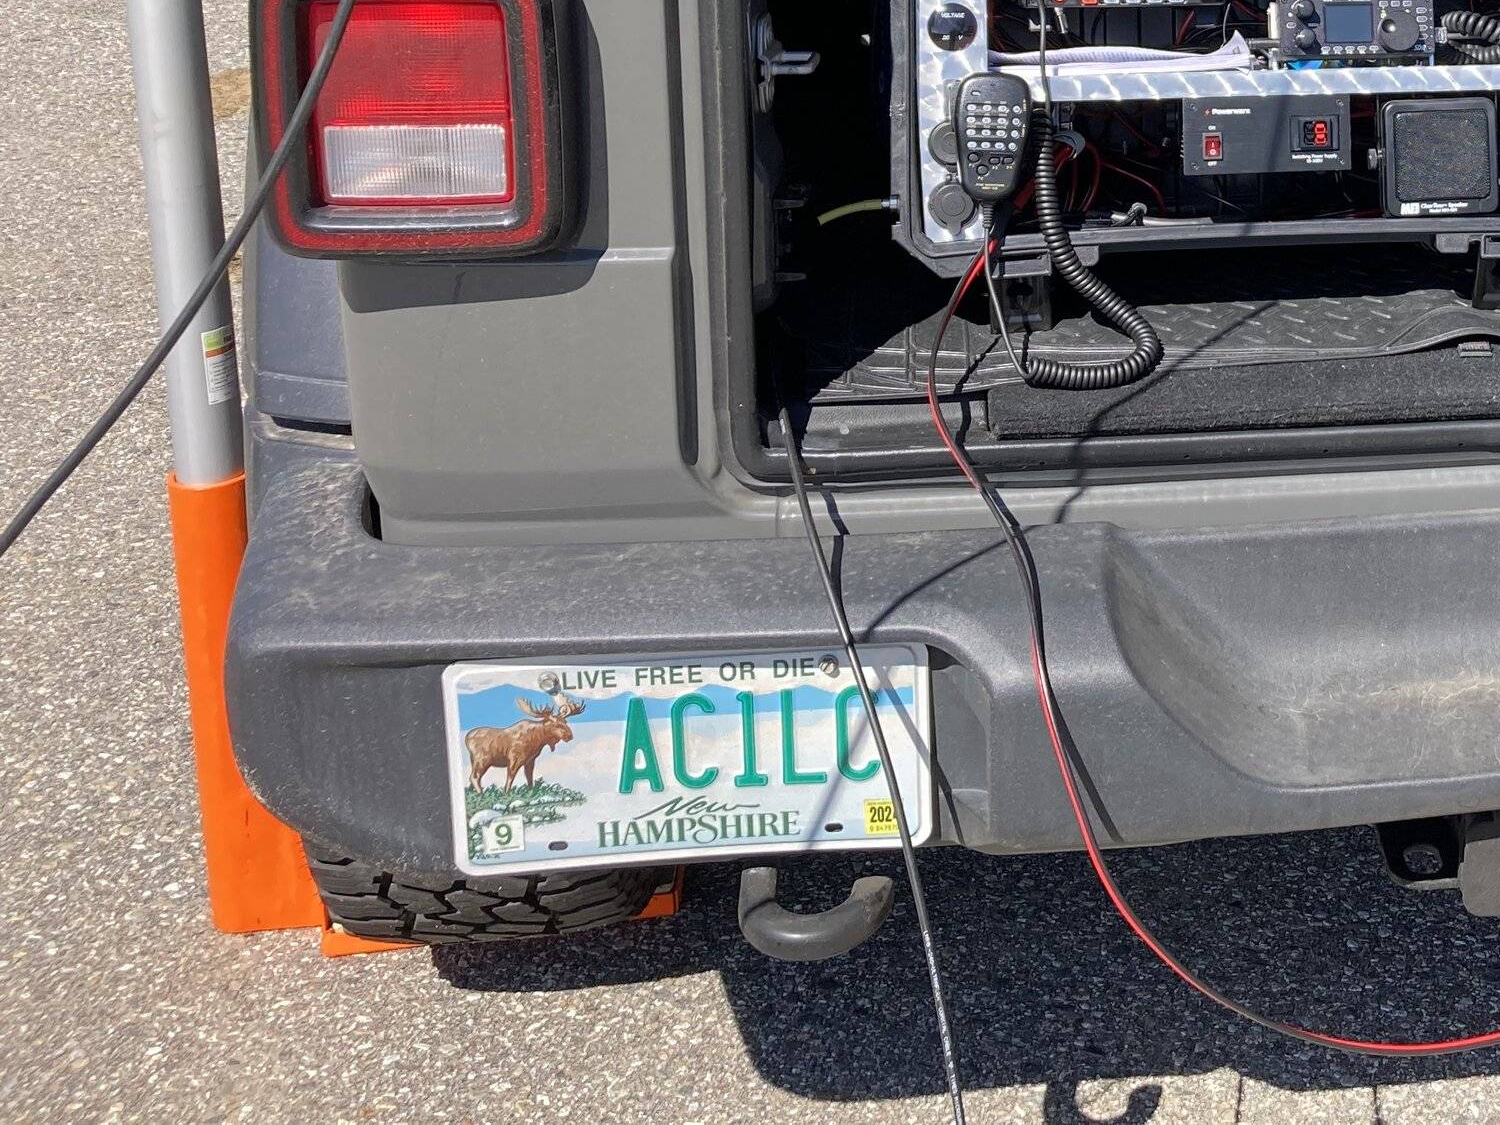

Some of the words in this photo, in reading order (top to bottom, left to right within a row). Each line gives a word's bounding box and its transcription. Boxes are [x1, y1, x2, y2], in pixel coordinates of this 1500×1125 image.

[562, 669, 617, 690] LIVE
[634, 665, 702, 686] FREE
[719, 662, 757, 682] OR
[773, 657, 815, 678] DIE
[619, 684, 881, 794] AC1LC
[633, 794, 760, 819] New
[495, 823, 512, 845] 9
[597, 810, 801, 848] HAMPSHIRE
